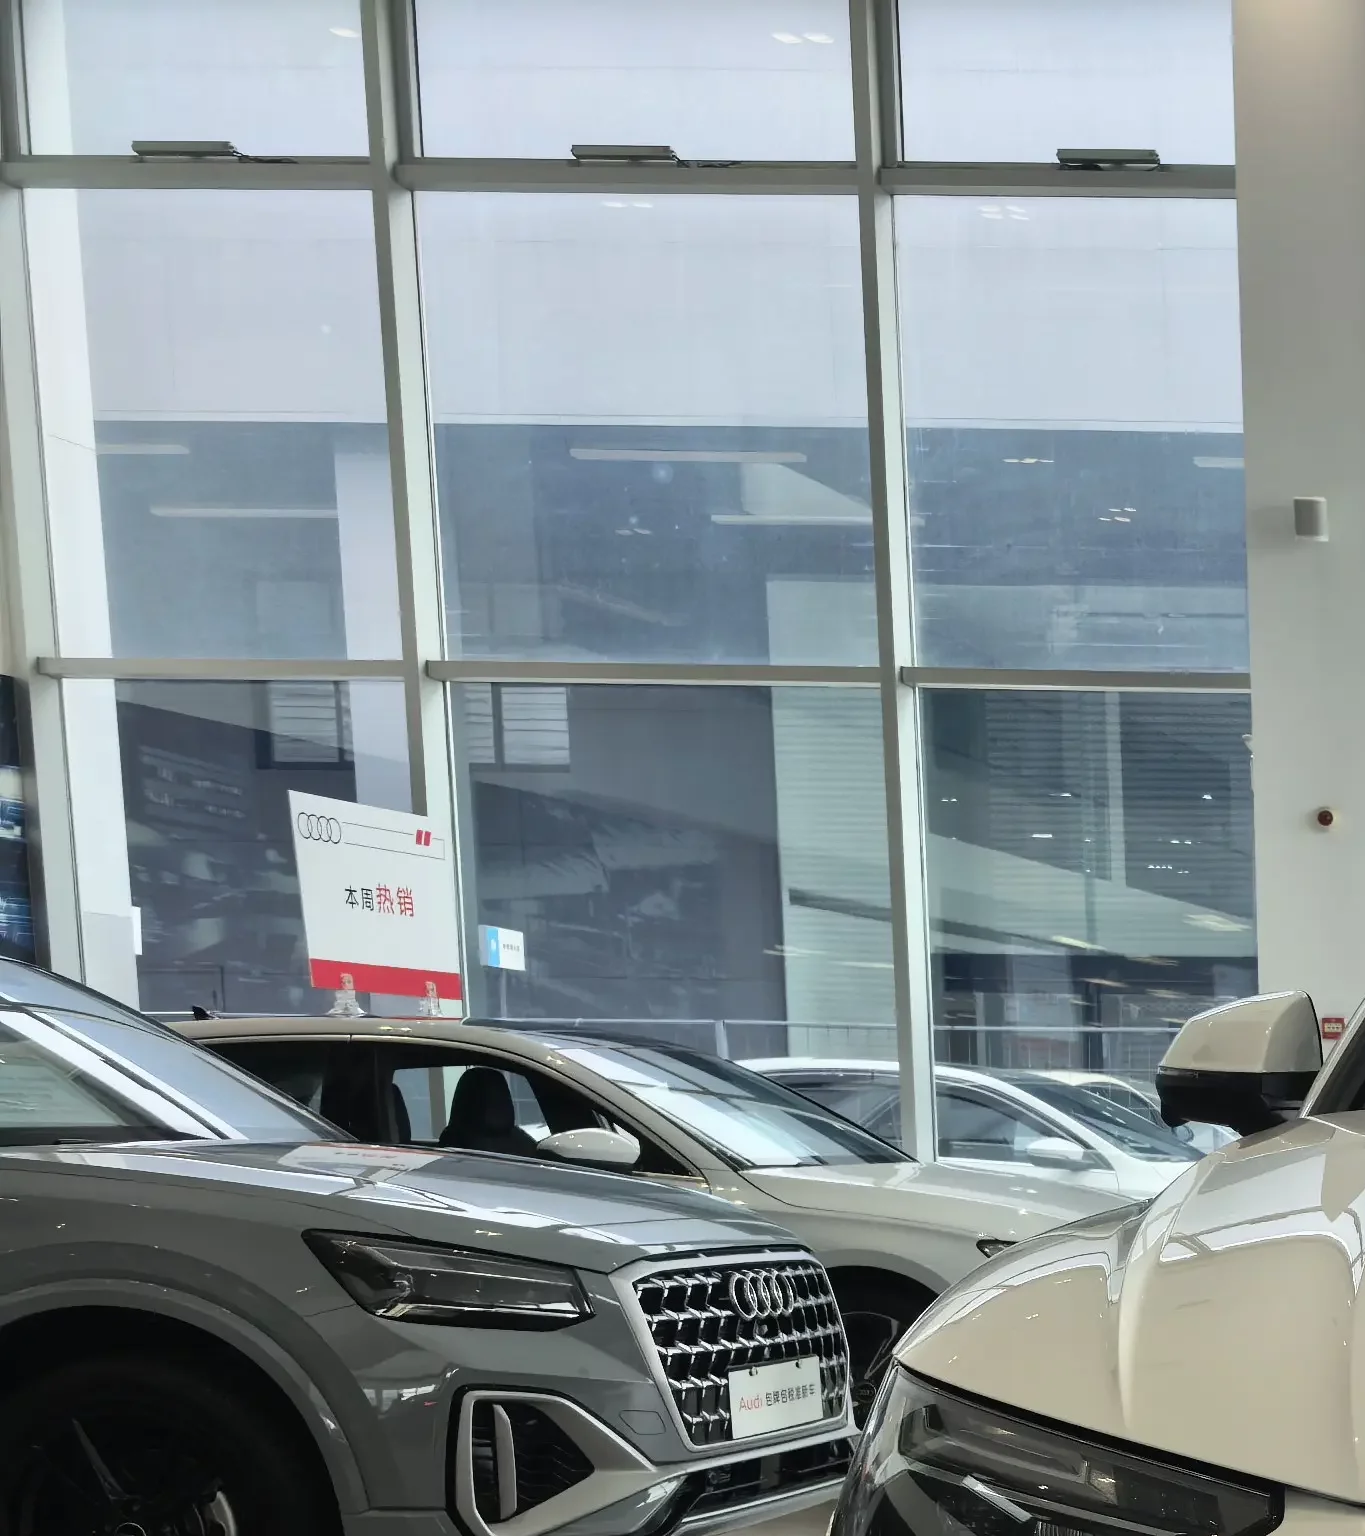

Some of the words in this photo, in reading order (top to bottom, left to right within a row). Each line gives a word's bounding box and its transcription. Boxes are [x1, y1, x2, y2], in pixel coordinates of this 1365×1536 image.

[344, 883, 415, 917] 本周热销
[739, 1395, 763, 1412] Audi
